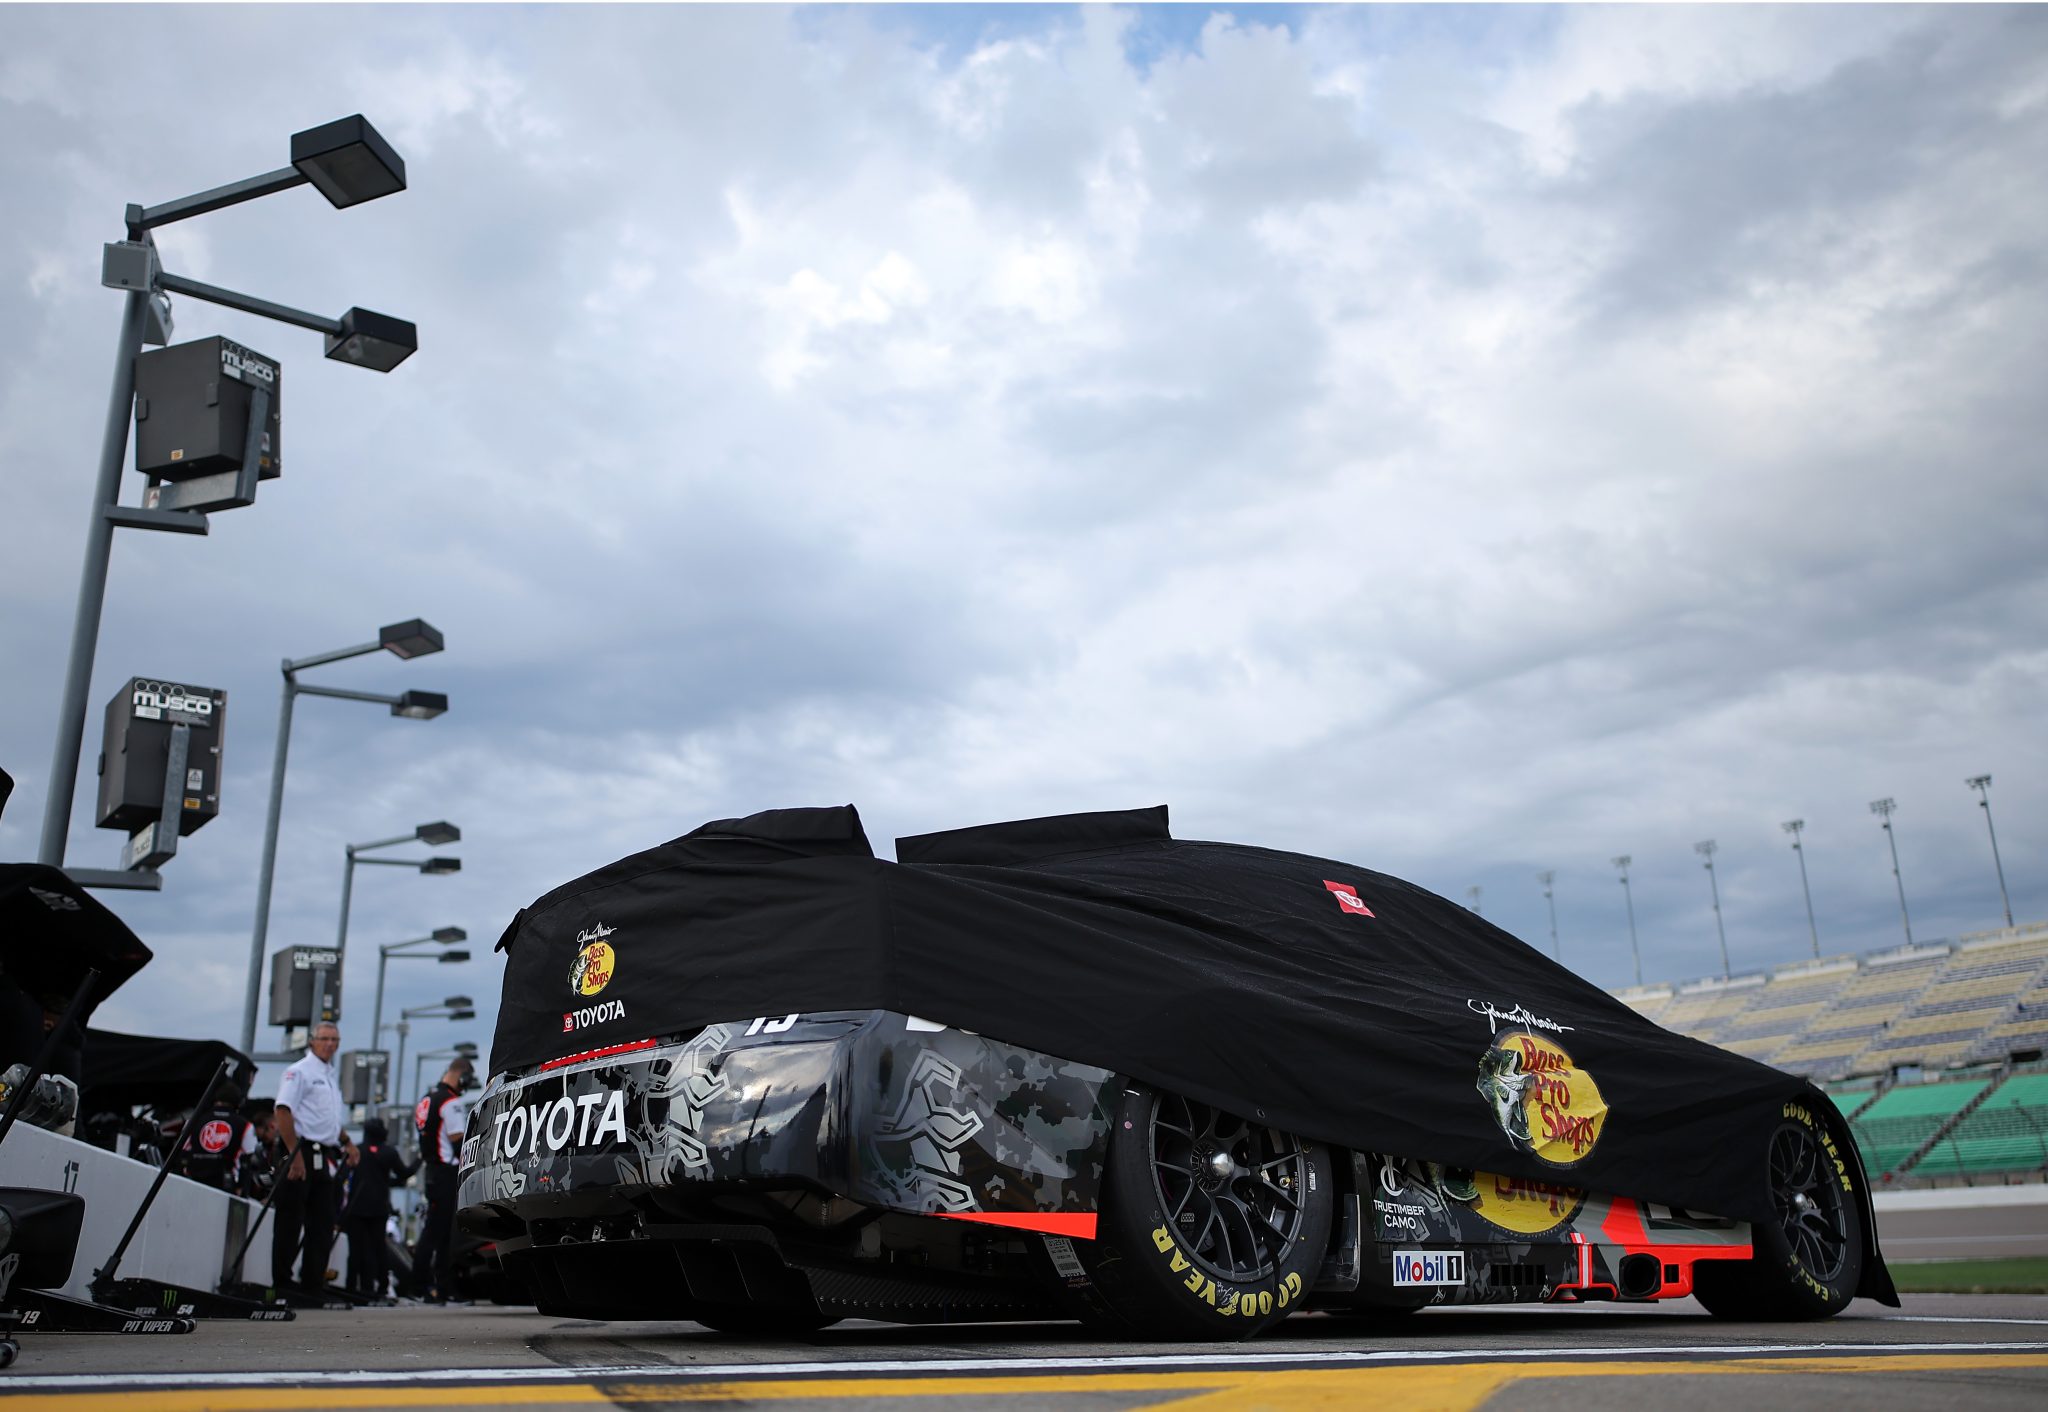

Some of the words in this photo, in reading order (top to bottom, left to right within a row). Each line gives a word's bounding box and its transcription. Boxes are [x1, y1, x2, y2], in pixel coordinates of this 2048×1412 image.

[588, 945, 606, 960] Bass
[587, 959, 601, 973] Pro
[586, 971, 609, 988] Shops
[572, 1000, 626, 1029] TOYOTA
[1533, 1074, 1571, 1108] Pro
[491, 1090, 627, 1162] TOYOTA
[1541, 1102, 1595, 1154] Shops
[1373, 1199, 1426, 1216] TRUETIMBER
[1384, 1214, 1417, 1229] CAMO
[1395, 1255, 1444, 1282] Mobil
[1450, 1257, 1457, 1280] 1
[20, 1310, 41, 1324] 19
[121, 1320, 143, 1332] PIT
[141, 1320, 174, 1332] VIPER
